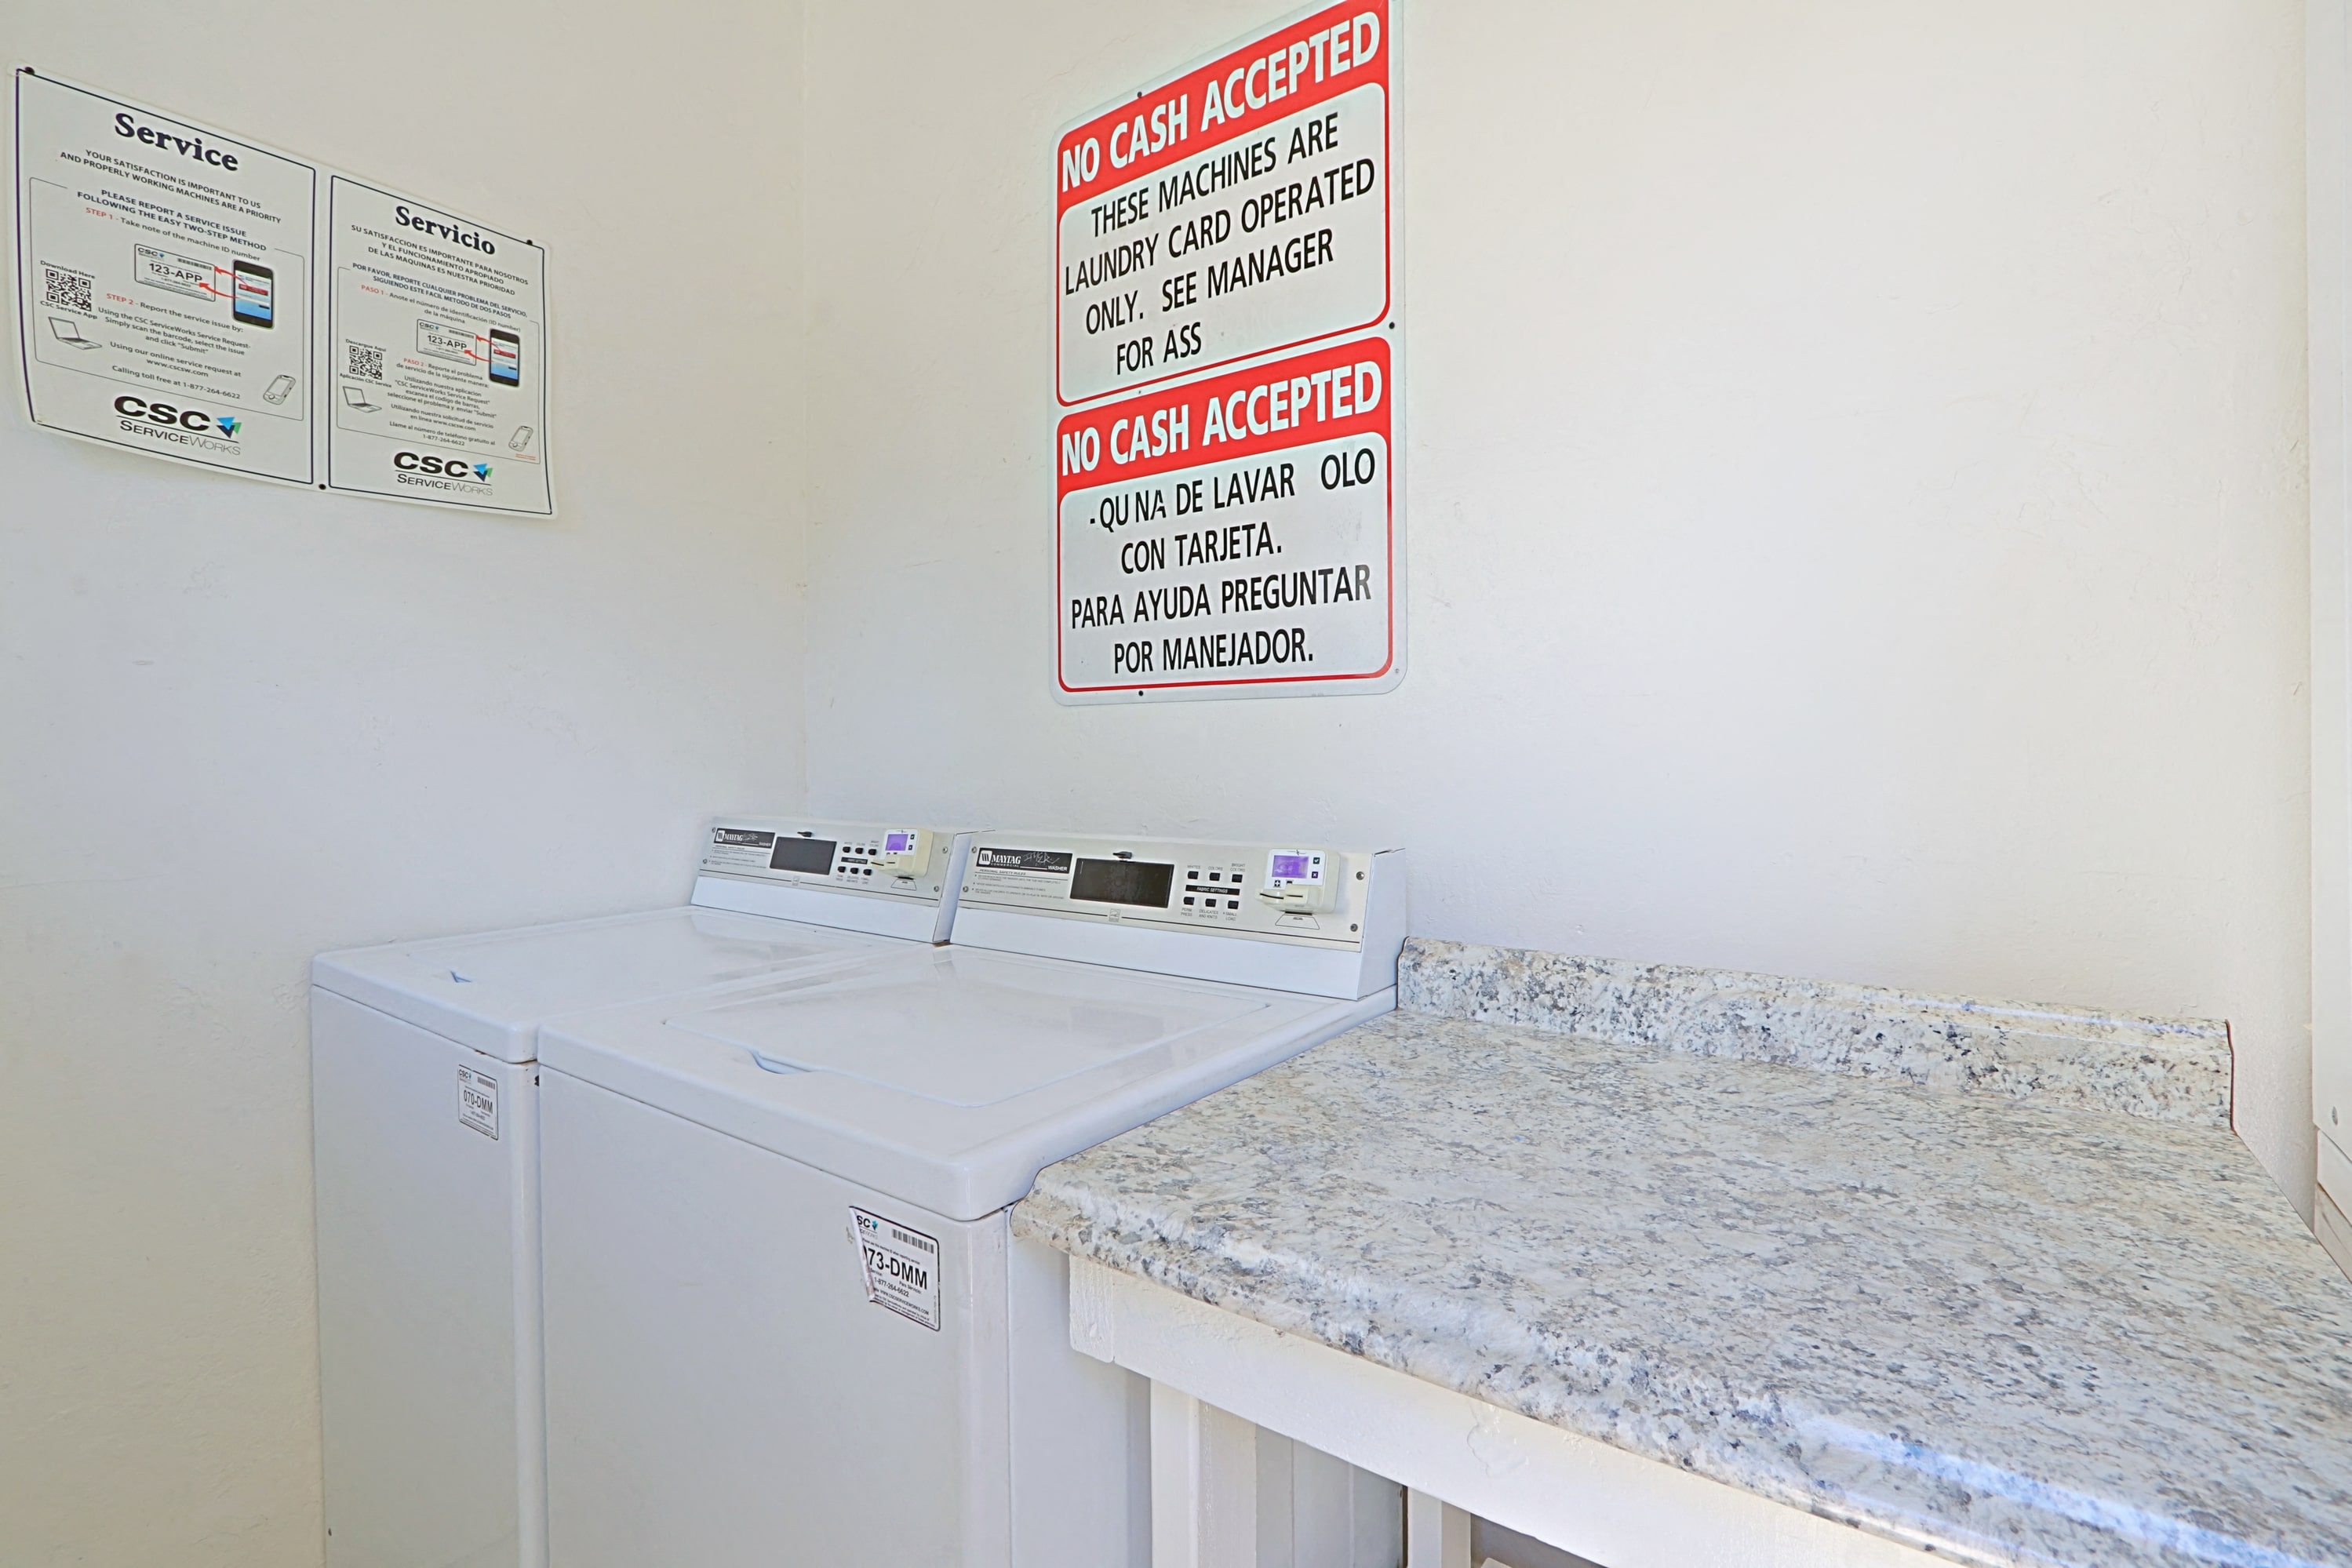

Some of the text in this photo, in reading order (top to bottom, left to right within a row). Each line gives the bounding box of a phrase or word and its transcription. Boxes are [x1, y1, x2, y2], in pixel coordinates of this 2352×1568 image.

[1062, 11, 1380, 192] NO CASH ACCEPTED
[115, 112, 238, 171] Service
[60, 151, 81, 162] AND
[83, 158, 129, 177] PROPERLY
[132, 173, 174, 191] WORKING
[176, 186, 219, 205] MACHINES
[221, 199, 236, 209] ARE
[246, 207, 281, 223] PRIORITY
[86, 148, 260, 208] YOUR SATISFACTION IS IMPORTANT TO US
[1091, 112, 1338, 237] THESE MACHINES ARE
[77, 191, 136, 213] FOLLOWING
[138, 209, 155, 219] THE
[158, 214, 181, 226] EASY
[230, 235, 266, 250] METHOD
[86, 206, 107, 217] STEP
[120, 216, 140, 227] Take
[142, 224, 160, 233] note
[172, 231, 185, 240] the
[187, 237, 220, 249] machine
[231, 249, 260, 260] number
[101, 189, 136, 205] PLEASE
[139, 200, 174, 215] REPORT
[185, 213, 220, 228] SERVICE
[223, 224, 246, 236] ISSUE
[395, 207, 495, 254] Servicio
[1065, 158, 1375, 295] LAUNDRY CARD OPERATED
[40, 260, 77, 274] Download
[149, 263, 202, 280] 123-APP
[1087, 229, 1334, 334] ONLY. SEE MANAGER
[98, 307, 119, 318] Using
[134, 315, 147, 324] CSC
[149, 318, 195, 335] ServiceWorks
[197, 330, 220, 341] Service
[106, 292, 126, 303] STEP
[140, 300, 167, 313] Report
[169, 308, 182, 317] the
[184, 313, 209, 324] service
[211, 318, 230, 329] issue
[105, 316, 130, 329] Simply
[149, 326, 162, 335] the
[195, 339, 214, 347] select
[216, 342, 227, 351] the
[228, 345, 245, 355] issue
[110, 340, 133, 353] Using
[150, 351, 174, 361] online
[176, 358, 202, 367] service
[204, 364, 232, 374] request
[160, 337, 176, 346] click
[427, 337, 466, 347] 123-APP
[1116, 322, 1202, 375] FOR ASS
[111, 364, 140, 377] Calling
[141, 371, 155, 380] toll
[156, 374, 171, 383] free
[114, 396, 210, 432] CSC
[1062, 361, 1382, 476] NO CASH ACCEPTED
[394, 454, 468, 476] CSC
[1177, 480, 1203, 515] DE
[1214, 463, 1295, 509] LAVAR
[1121, 522, 1281, 574] CON TARJETA.
[1072, 564, 1371, 629] PARA AYUDA PREGUNTAR
[1115, 628, 1313, 674] POR MANEJADOR.
[992, 855, 1021, 864] MAYTAG
[459, 1069, 469, 1079] CSC
